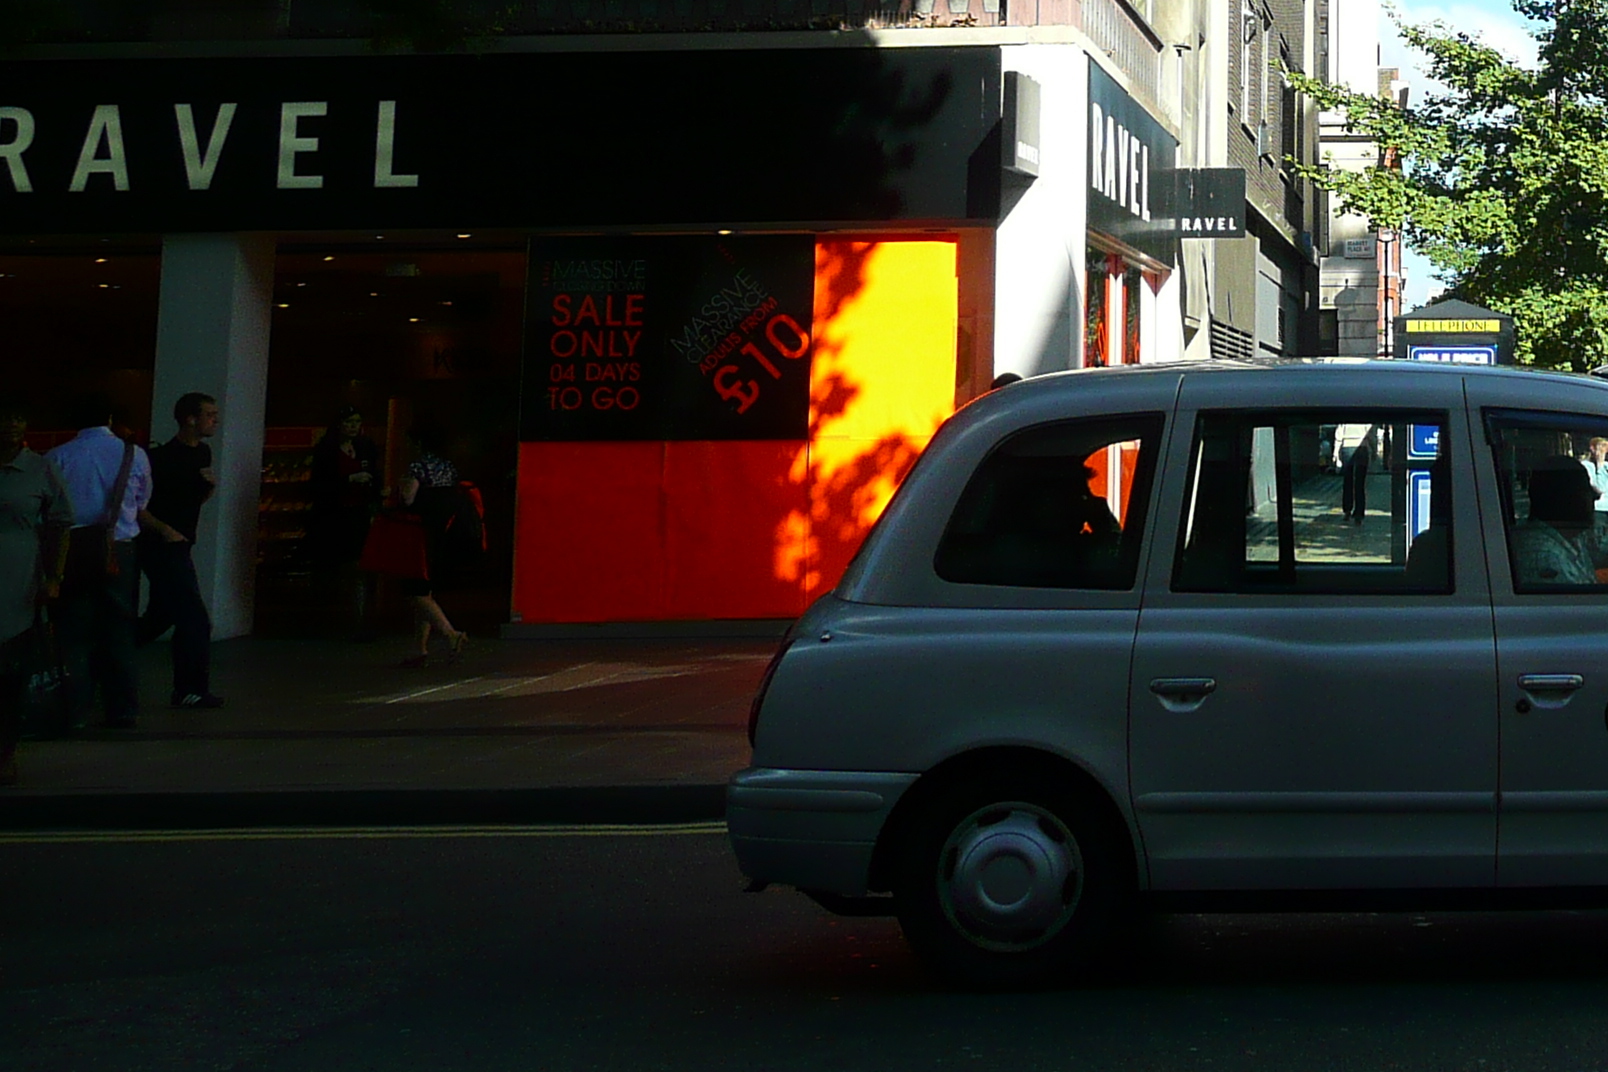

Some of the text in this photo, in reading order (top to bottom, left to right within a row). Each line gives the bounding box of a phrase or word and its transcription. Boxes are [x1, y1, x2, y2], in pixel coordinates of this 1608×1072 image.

[0, 100, 419, 192] RAVEL
[1092, 102, 1151, 223] RAVEL
[1181, 218, 1237, 232] RAVEL
[552, 259, 647, 280] MASSIVE
[551, 294, 647, 328] SALE
[670, 267, 757, 354] MASSIVE
[687, 281, 768, 364] CLEARANCE
[699, 295, 779, 376] ADULTS FROM
[549, 329, 641, 358] ONLY
[714, 313, 810, 415] £10
[547, 386, 641, 411] TO GO
[549, 362, 641, 383] 04 DAYS
